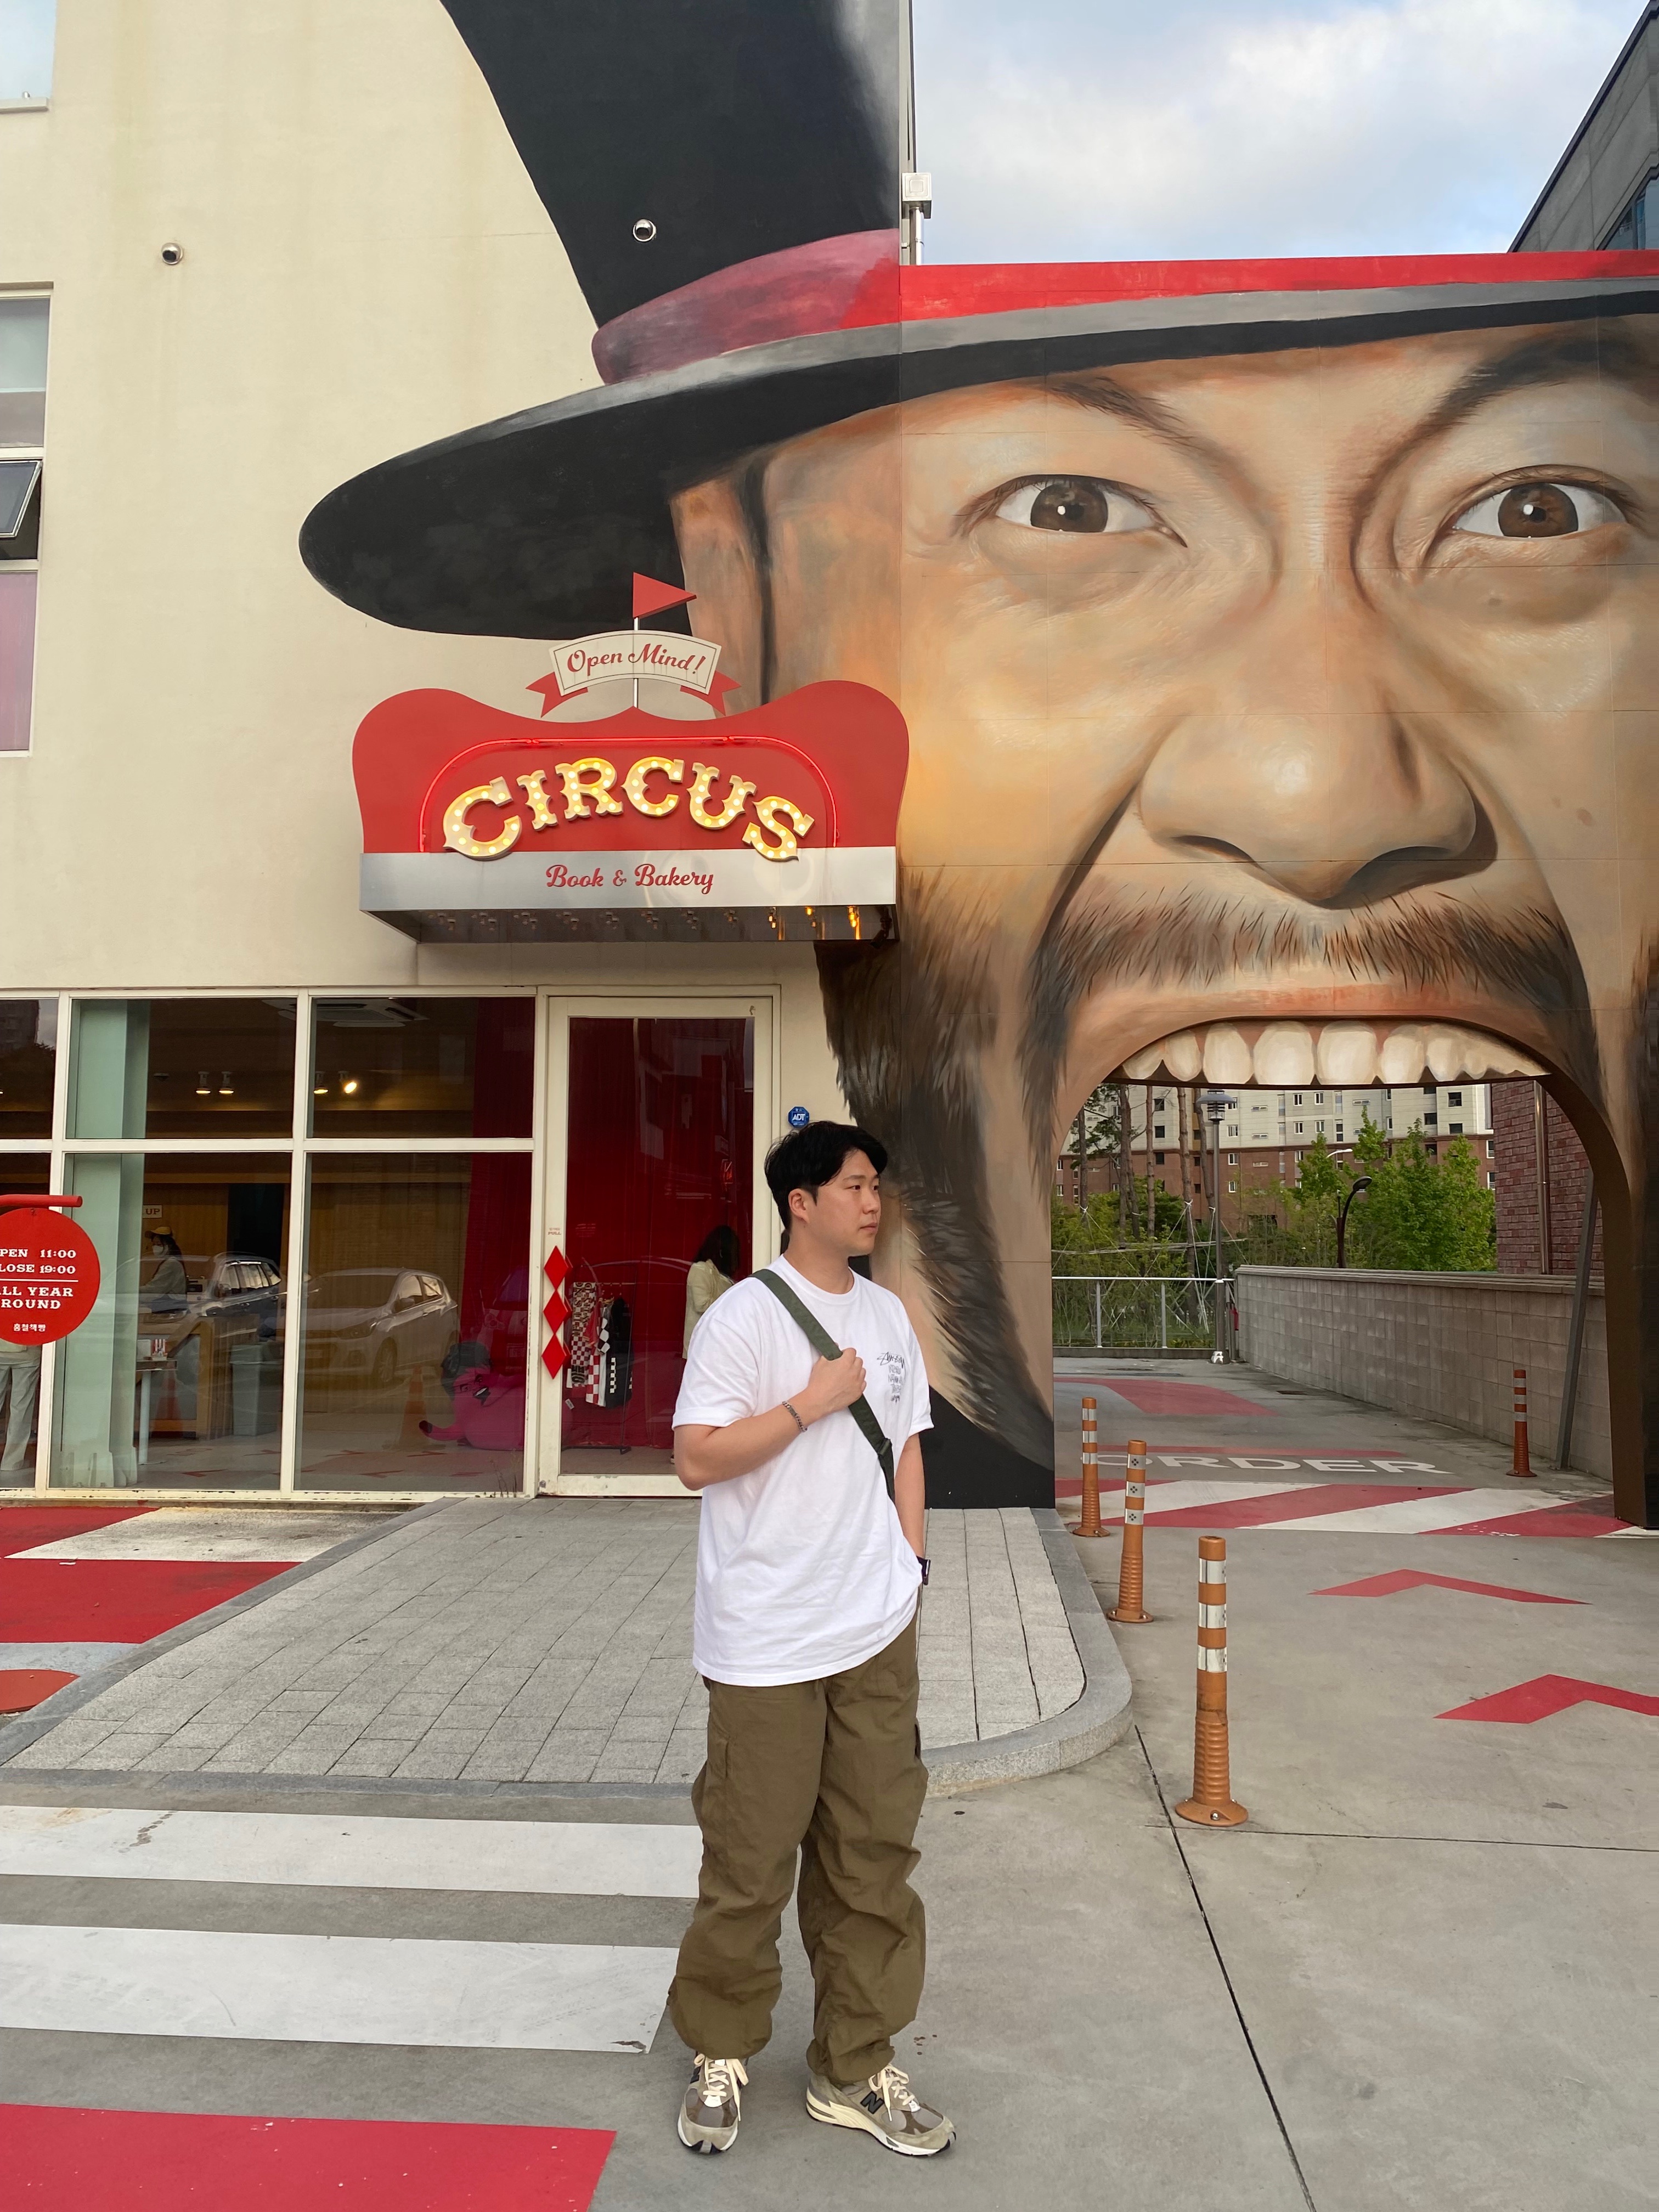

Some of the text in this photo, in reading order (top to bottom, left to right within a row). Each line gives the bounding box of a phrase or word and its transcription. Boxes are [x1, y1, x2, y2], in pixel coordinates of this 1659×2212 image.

[567, 643, 706, 676] Open Mind!
[443, 756, 815, 861] CIRCUS
[546, 864, 714, 895] Book & Bakery
[40, 1249, 76, 1259] 11:00
[40, 1265, 76, 1274] 19:00
[0, 1286, 73, 1296] LL YEAR
[1, 1299, 61, 1309] ROUND
[860, 2091, 884, 2114] N
